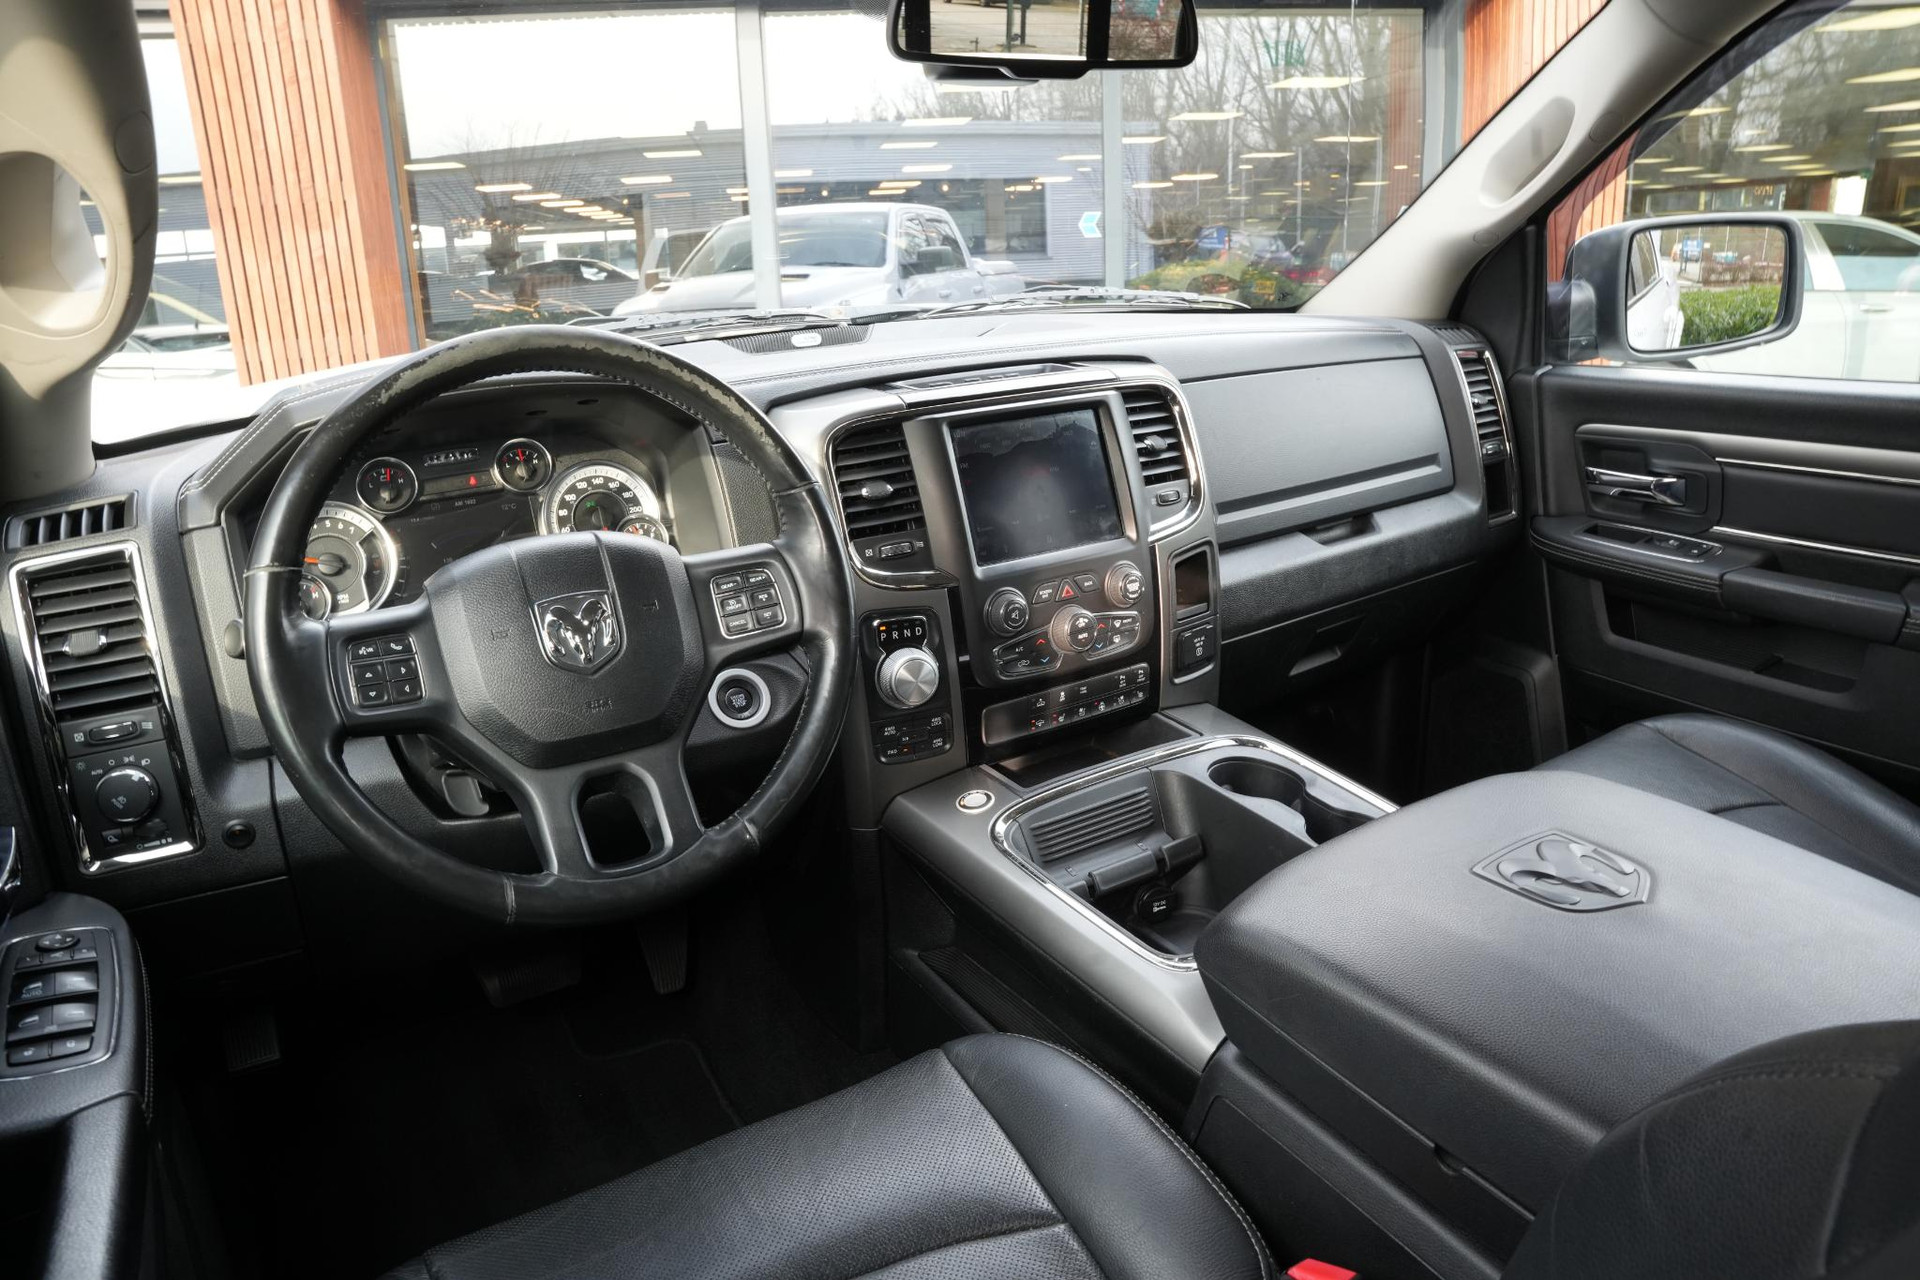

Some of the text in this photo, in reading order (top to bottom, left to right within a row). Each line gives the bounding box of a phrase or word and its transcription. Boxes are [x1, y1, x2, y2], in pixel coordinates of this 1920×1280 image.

[591, 477, 604, 485] 140
[608, 481, 620, 489] 160
[575, 481, 588, 490] 120
[564, 493, 576, 501] 100
[558, 508, 568, 516] 80
[629, 505, 642, 513] 200
[325, 519, 331, 528] 5
[338, 521, 343, 529] 6
[349, 526, 355, 534] 7
[561, 526, 571, 534] 60
[729, 619, 747, 627] CANCEL
[880, 626, 922, 642] P R N D
